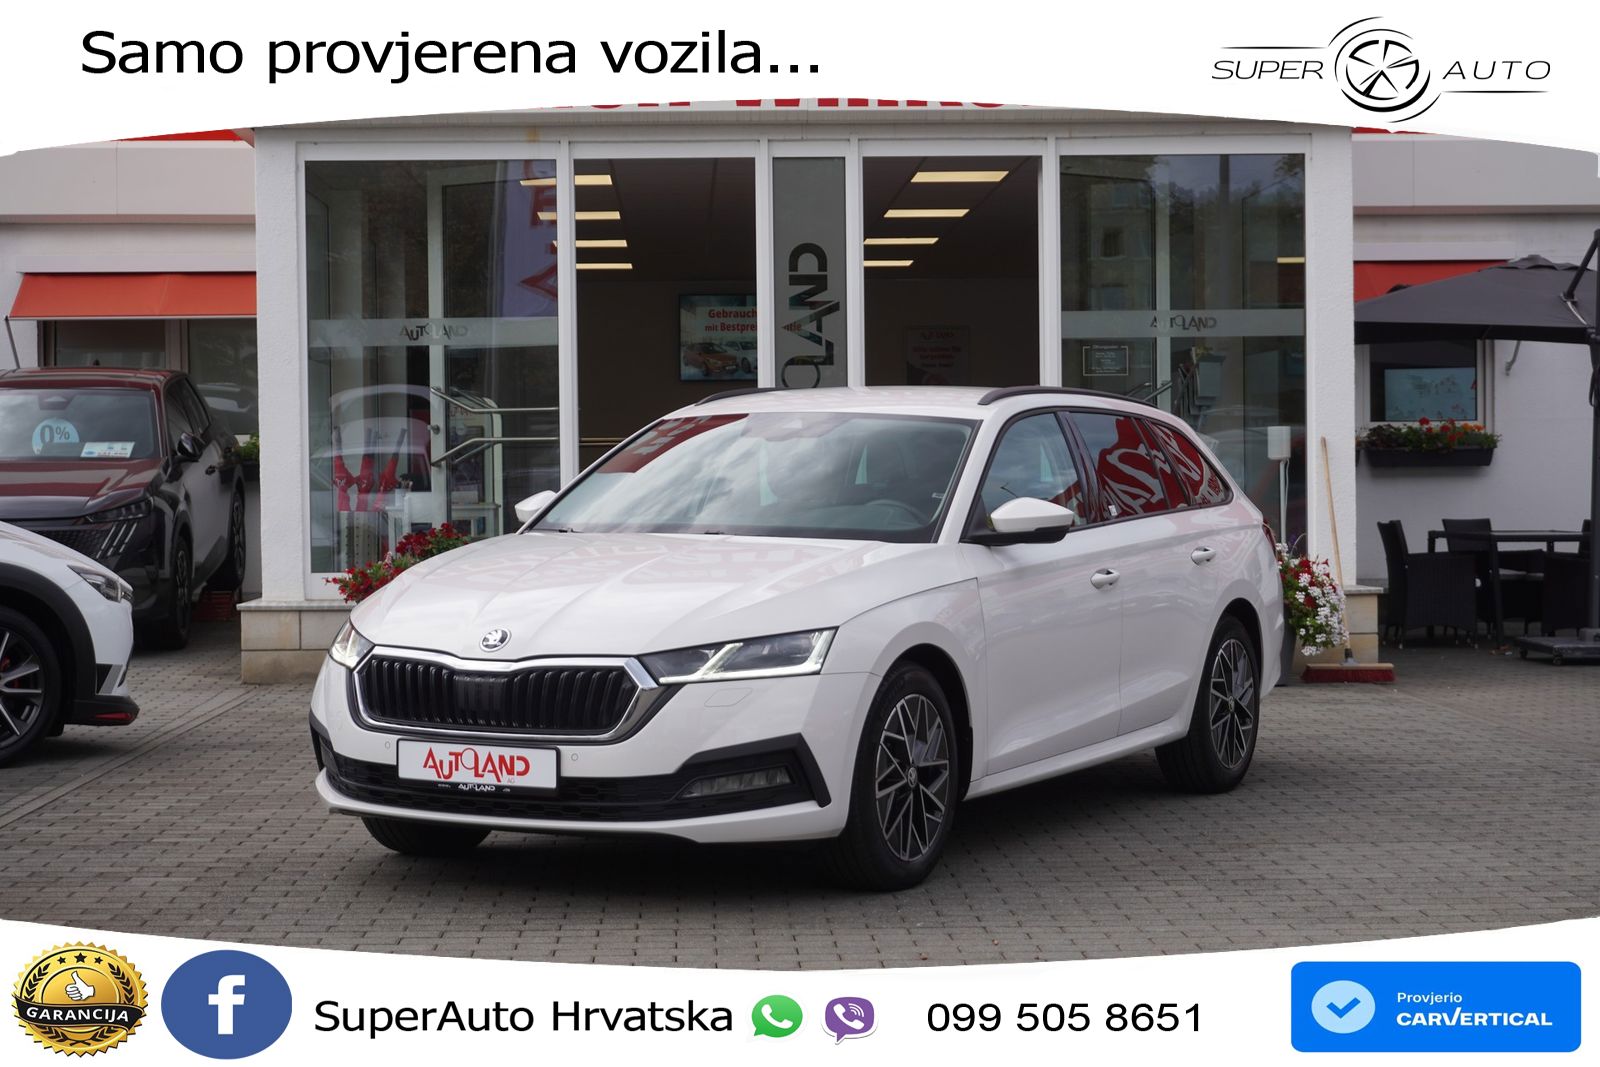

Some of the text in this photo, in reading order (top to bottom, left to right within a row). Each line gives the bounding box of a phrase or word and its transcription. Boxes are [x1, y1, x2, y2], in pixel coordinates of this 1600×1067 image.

[708, 308, 757, 320] Gebrauch
[781, 242, 840, 388] OLAND
[704, 322, 718, 332] mit
[1150, 314, 1217, 332] ATOLAND
[423, 747, 530, 783] AUTOLAND
[458, 783, 495, 792] AUTOLAND
